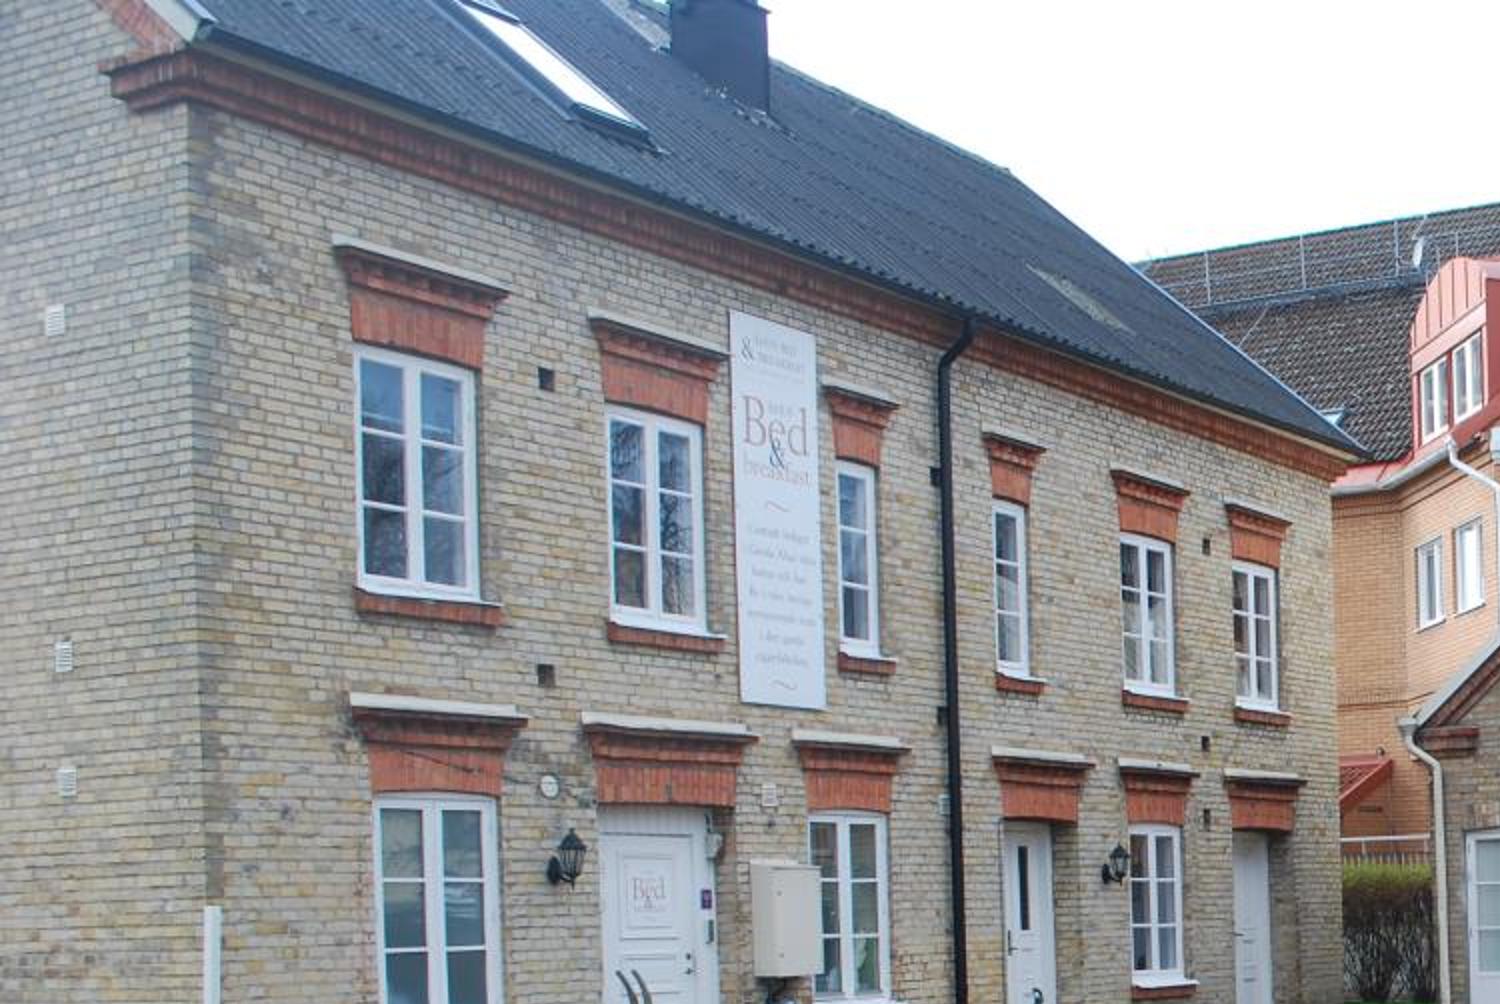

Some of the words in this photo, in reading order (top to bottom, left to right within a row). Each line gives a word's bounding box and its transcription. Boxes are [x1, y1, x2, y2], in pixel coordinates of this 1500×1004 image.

[741, 394, 808, 458] Bed
[743, 450, 810, 485] breakfast
[769, 436, 786, 470] &
